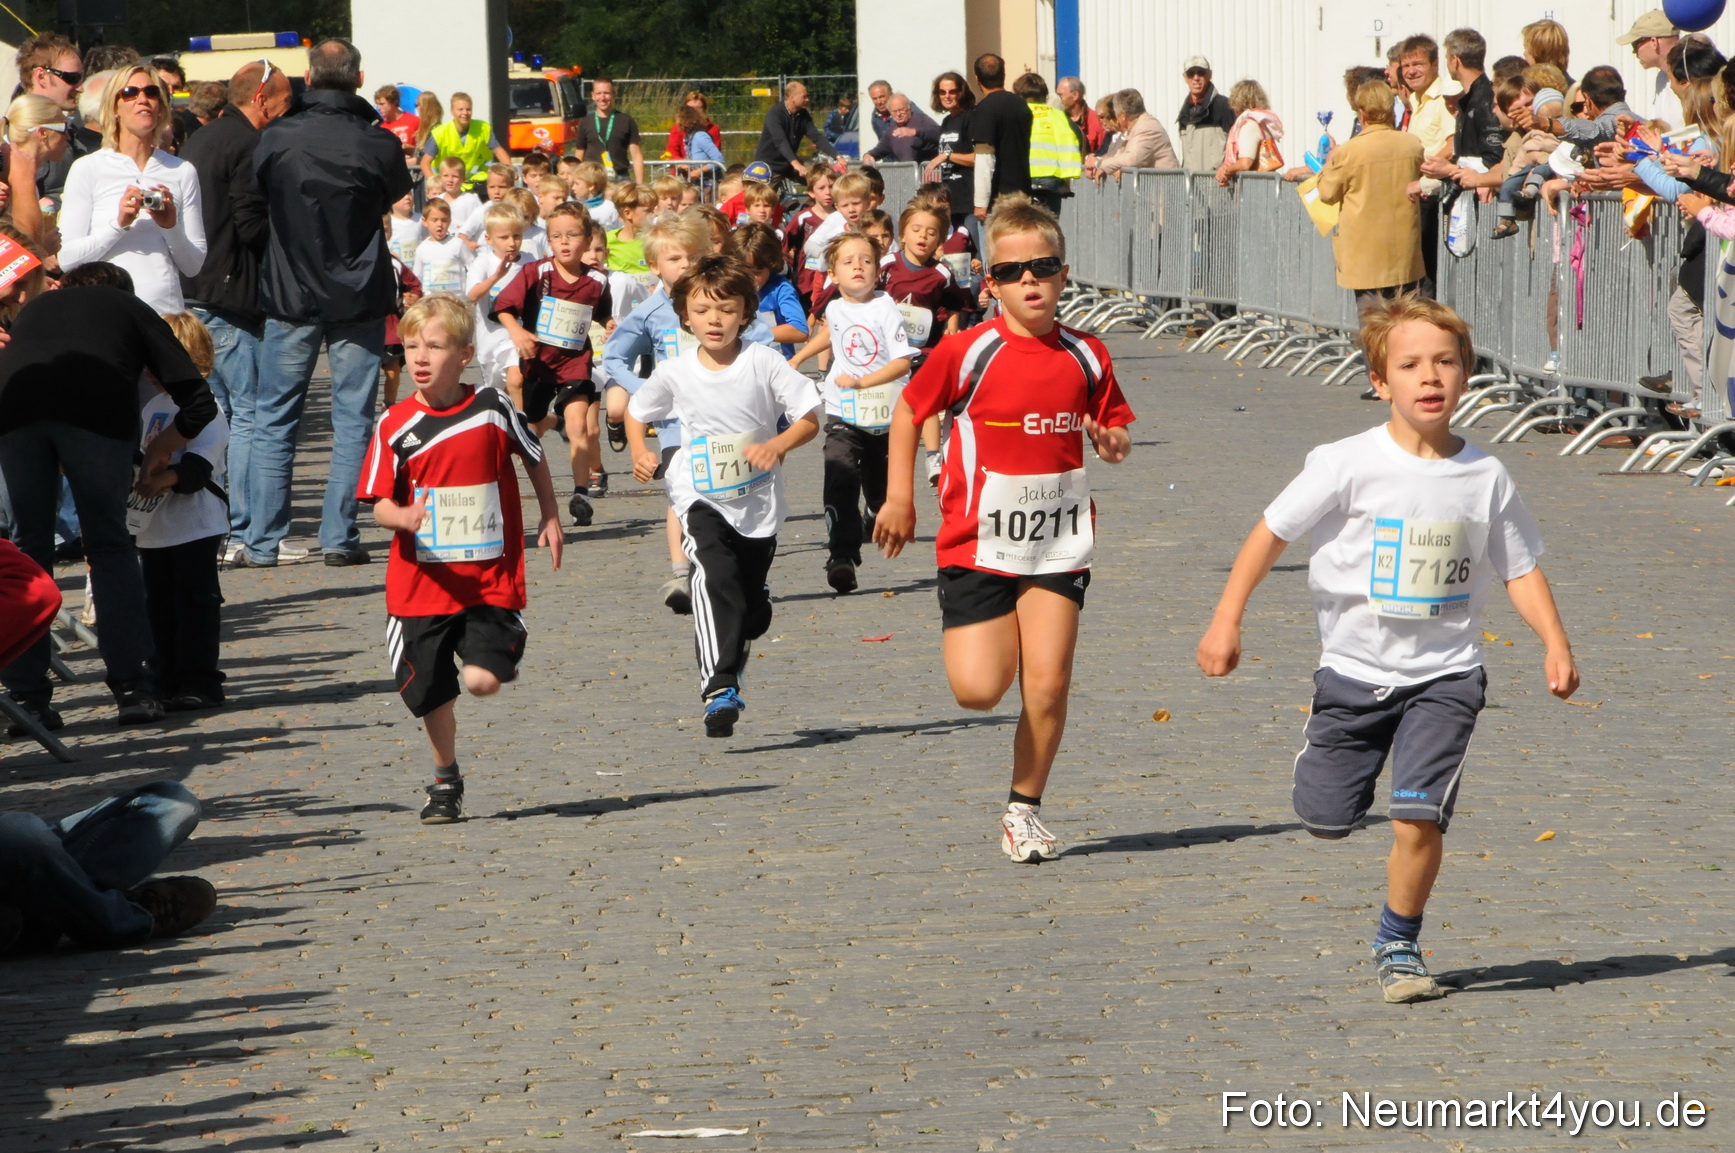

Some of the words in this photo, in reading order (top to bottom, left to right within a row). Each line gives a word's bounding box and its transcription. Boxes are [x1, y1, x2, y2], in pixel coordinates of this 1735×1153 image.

[1373, 19, 1384, 31] D
[555, 317, 586, 335] 7138
[857, 390, 885, 400] Fabian
[711, 441, 735, 455] Finn
[694, 463, 706, 473] K2
[439, 493, 476, 508] Niklas
[1018, 482, 1065, 505] Jakob
[442, 512, 497, 537] 7144
[987, 503, 1079, 542] 10211
[1409, 527, 1452, 547] Lukas
[1377, 554, 1394, 569] K2
[1408, 557, 1471, 586] 7126
